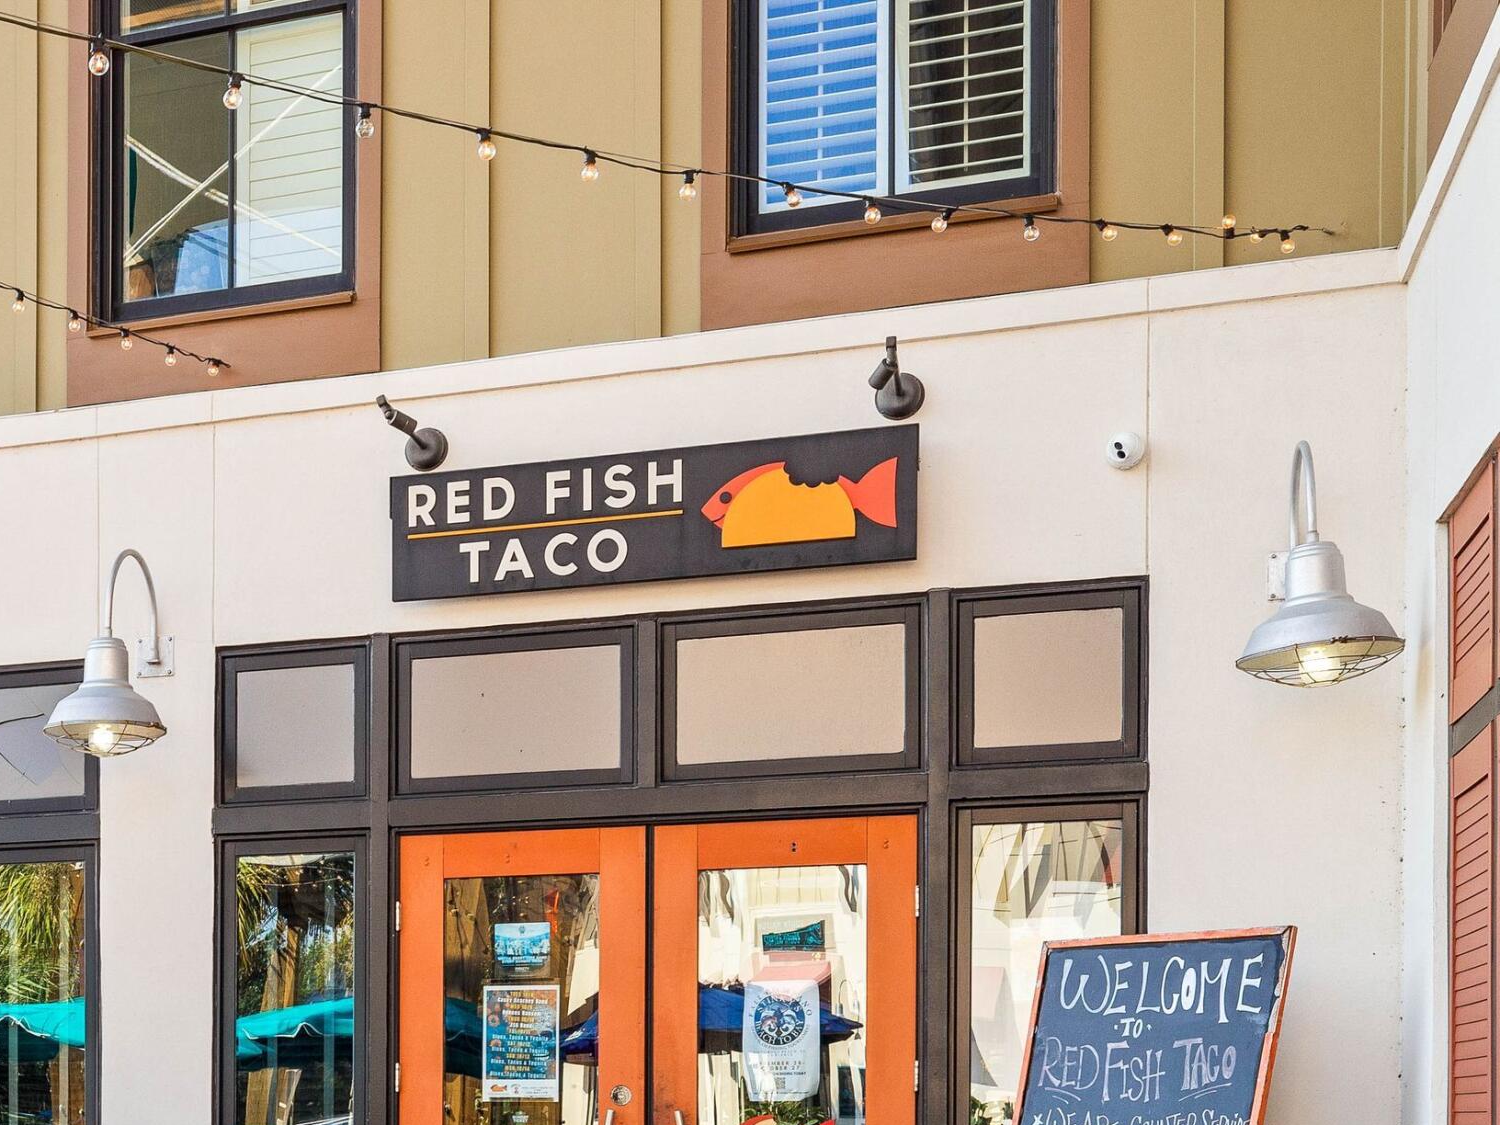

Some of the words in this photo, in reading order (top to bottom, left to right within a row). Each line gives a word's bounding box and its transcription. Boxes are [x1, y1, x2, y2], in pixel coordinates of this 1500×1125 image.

[408, 477, 516, 528] RED
[545, 458, 684, 516] FISH
[458, 528, 629, 583] TACO
[1060, 952, 1263, 1023] WELCOME
[1120, 1017, 1143, 1039] TO
[1038, 1036, 1100, 1091] RED
[1101, 1040, 1166, 1104] FISH
[1173, 1037, 1237, 1092] TACO
